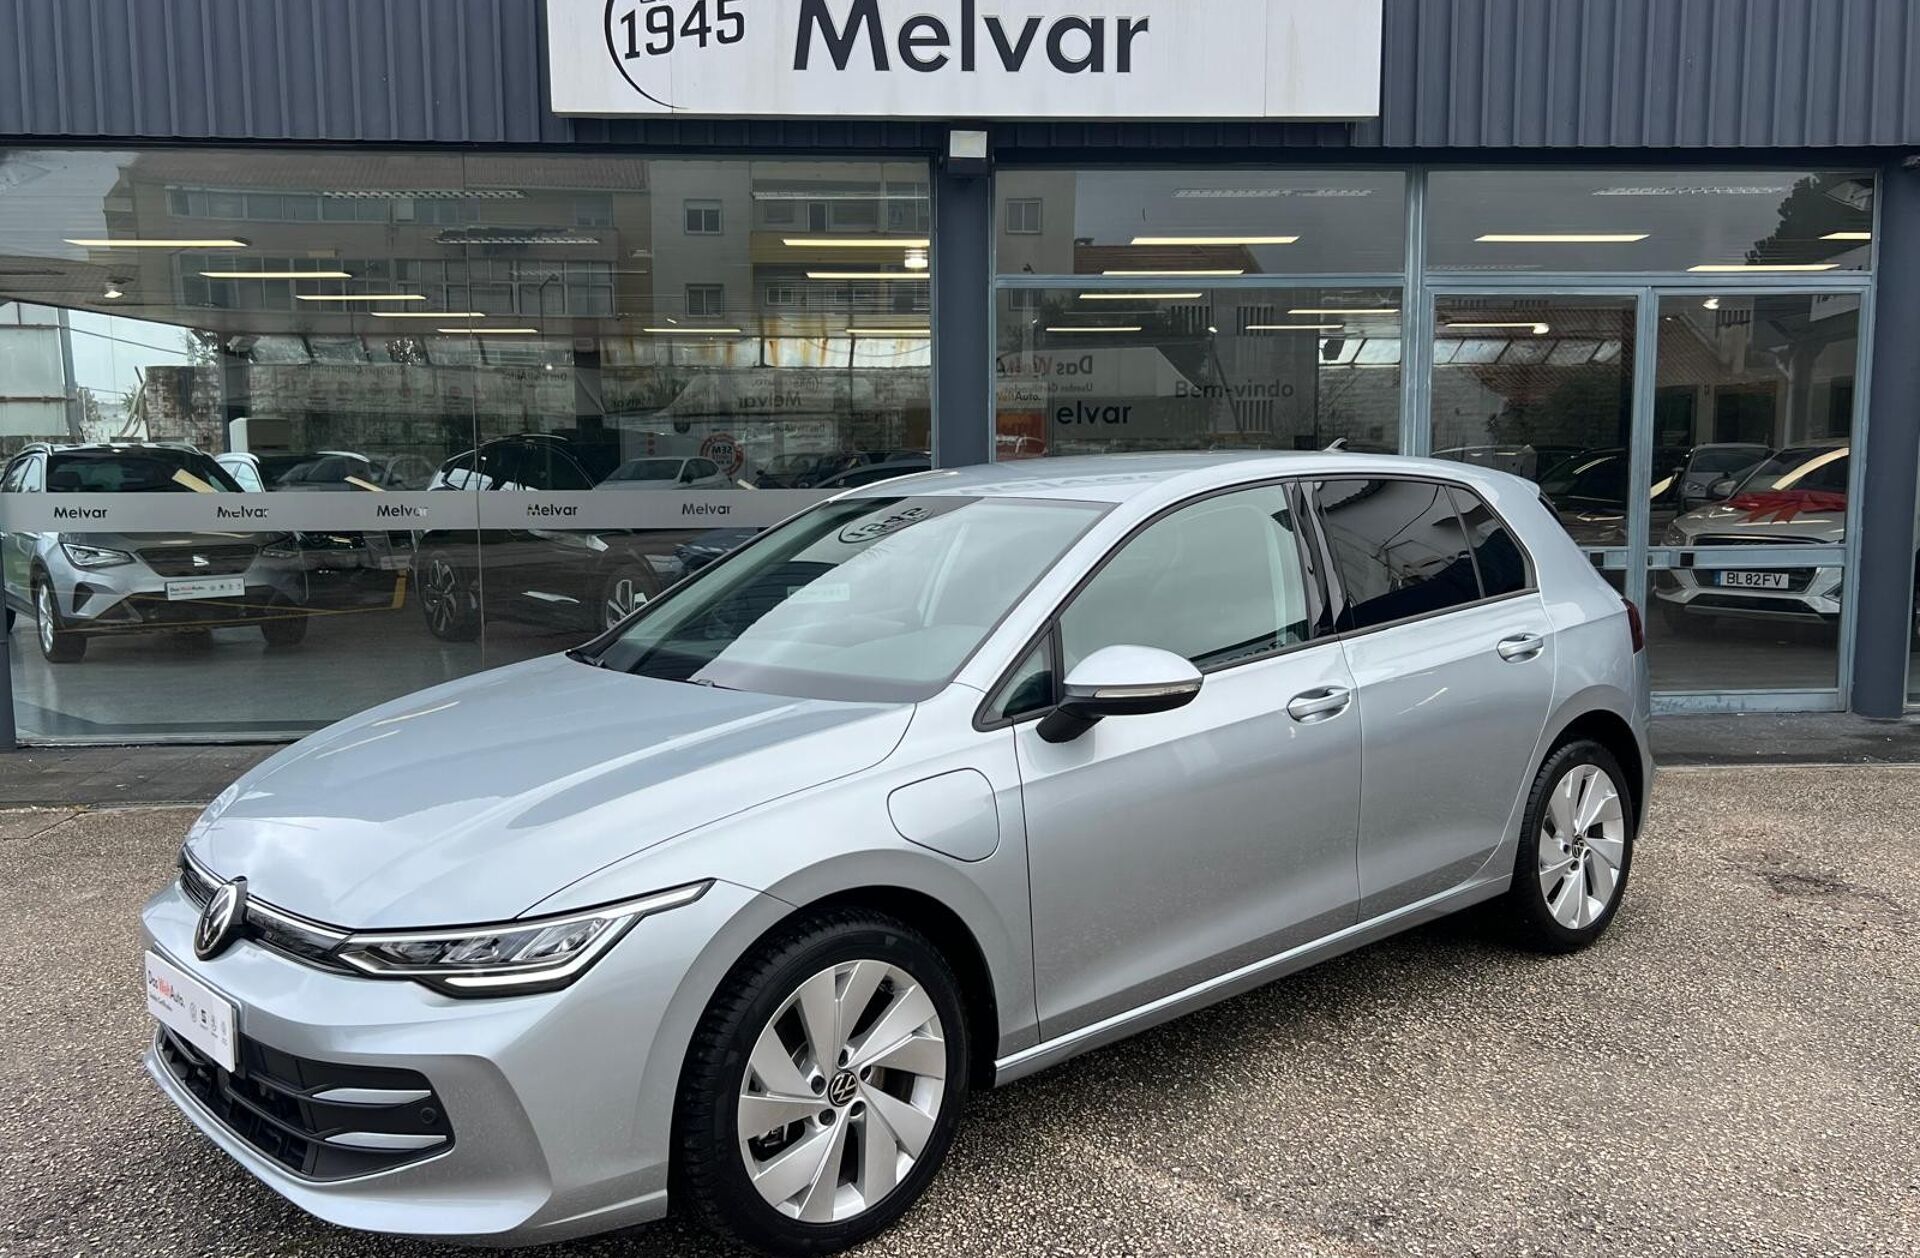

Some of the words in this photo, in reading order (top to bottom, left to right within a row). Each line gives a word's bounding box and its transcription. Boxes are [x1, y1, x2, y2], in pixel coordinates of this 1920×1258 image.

[620, 0, 745, 60] 1945
[793, 0, 1150, 74] Melvar
[1175, 379, 1294, 398] Bem-vindo
[1056, 400, 1133, 425] elvar
[54, 506, 108, 519] Melvar
[217, 505, 269, 518] Melvar
[377, 504, 430, 517] Melvar
[527, 503, 578, 516] Melvar
[682, 503, 732, 515] Melvar
